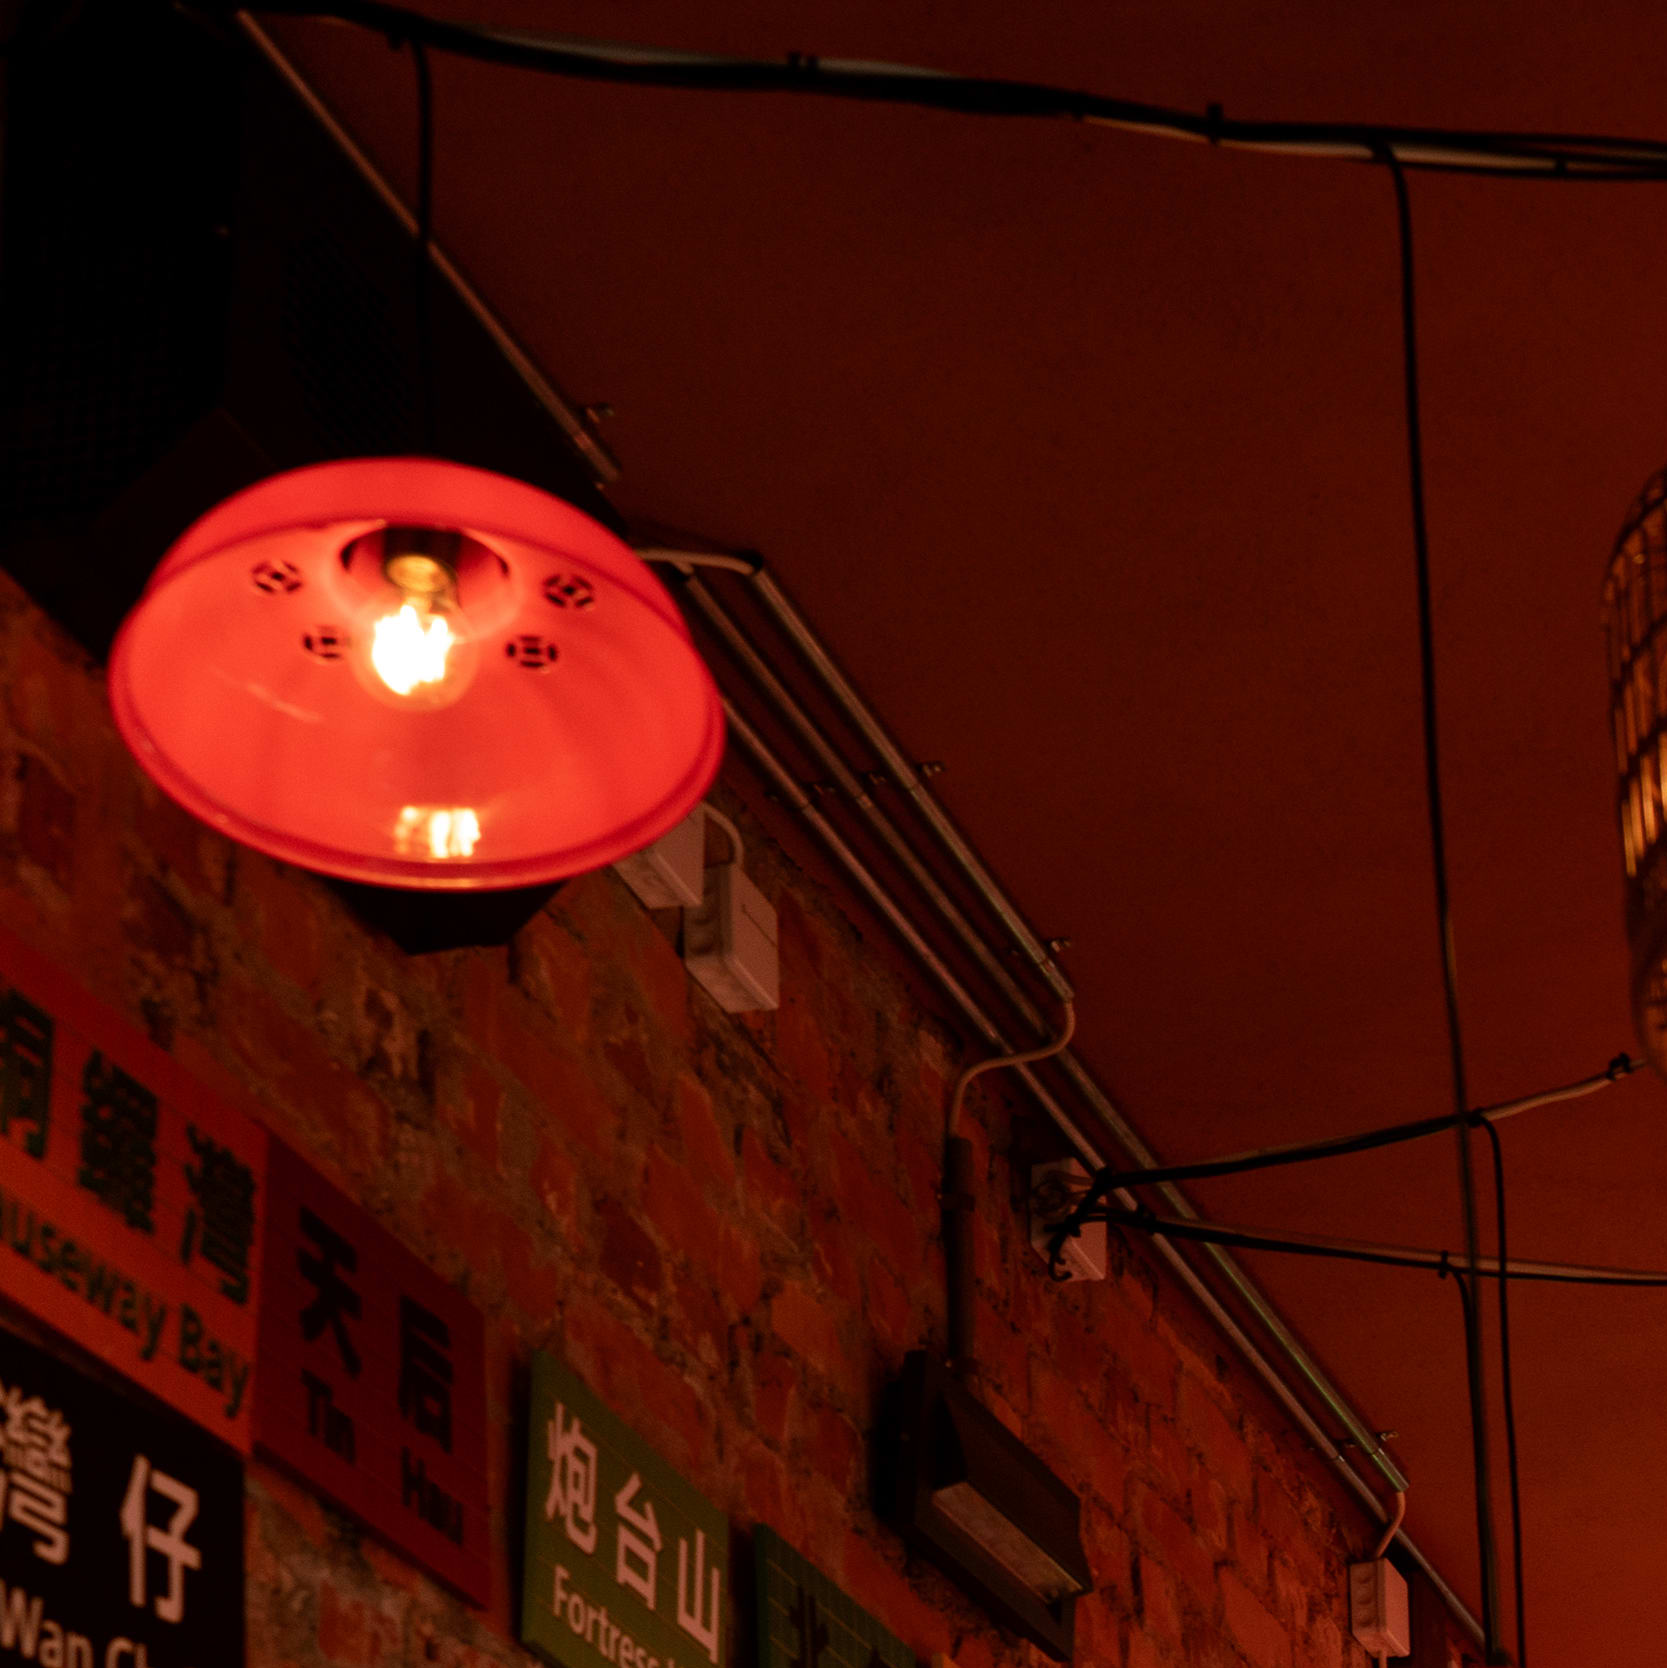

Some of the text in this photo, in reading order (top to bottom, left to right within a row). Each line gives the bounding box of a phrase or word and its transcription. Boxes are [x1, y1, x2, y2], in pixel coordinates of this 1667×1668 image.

[180, 1302, 249, 1419] Bay
[297, 1205, 453, 1455] 天后
[0, 1377, 202, 1625] 灣仔
[545, 1402, 721, 1665] 炮台山
